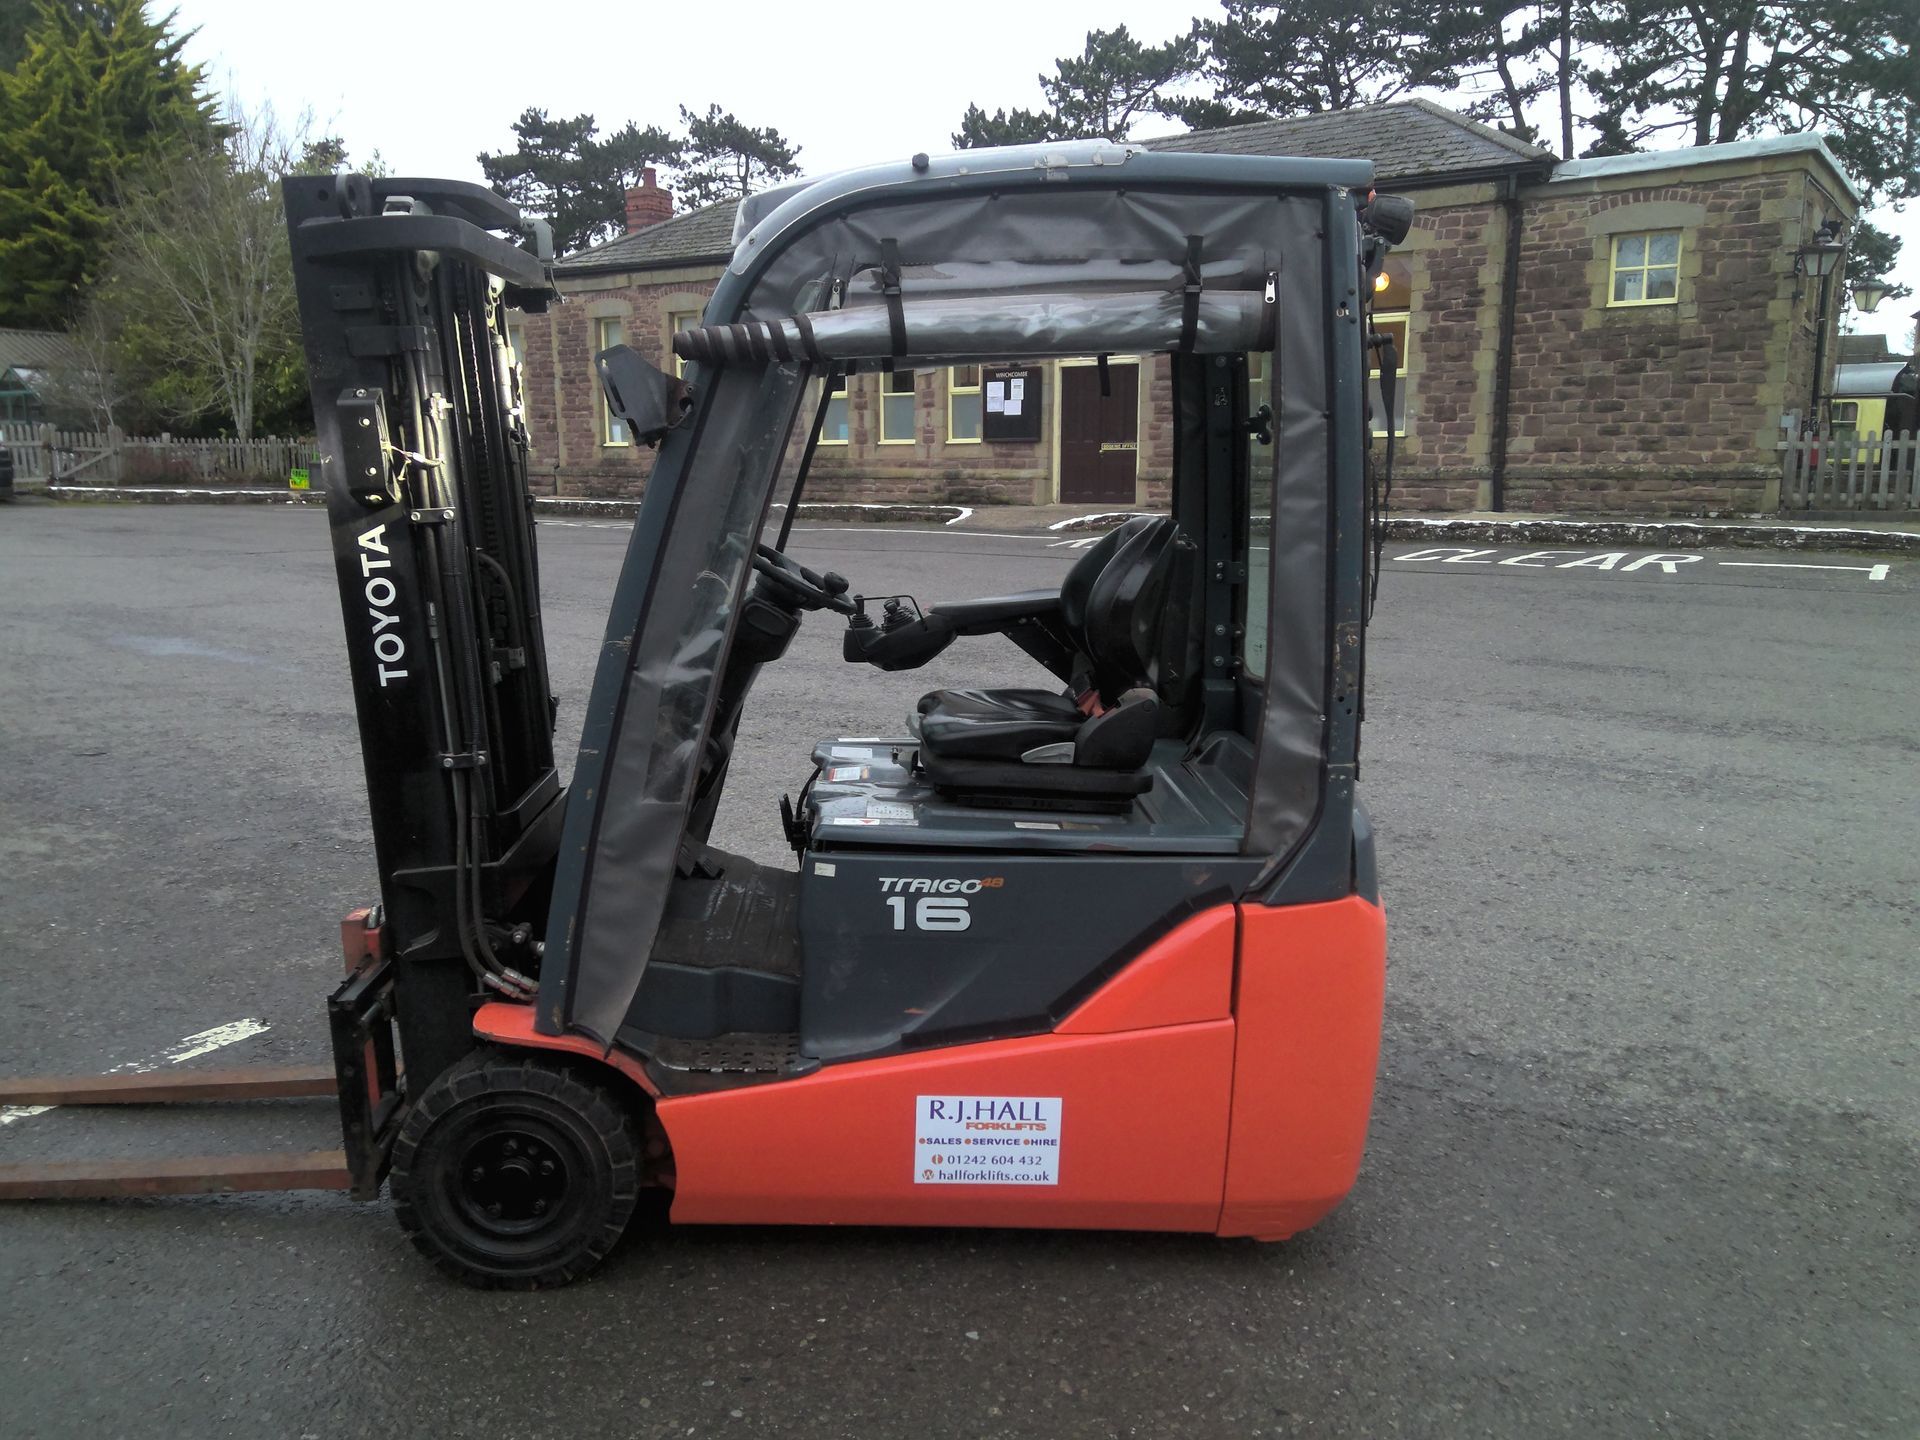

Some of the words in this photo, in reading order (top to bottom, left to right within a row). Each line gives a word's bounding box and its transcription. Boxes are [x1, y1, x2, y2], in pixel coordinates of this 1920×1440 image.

[1393, 548, 1704, 573] CLEAR
[358, 524, 408, 687] TOYOTA
[886, 896, 970, 931] 16
[965, 1122, 1047, 1131] FORKLIFTS
[926, 1137, 962, 1145] SALES
[972, 1138, 1021, 1146] SERVICE
[1030, 1139, 1057, 1147] HIRE
[947, 1155, 986, 1165] 01242
[991, 1156, 1014, 1165] 604
[1019, 1156, 1042, 1166] 432
[938, 1169, 1050, 1182] hallforklifts.co.uk
